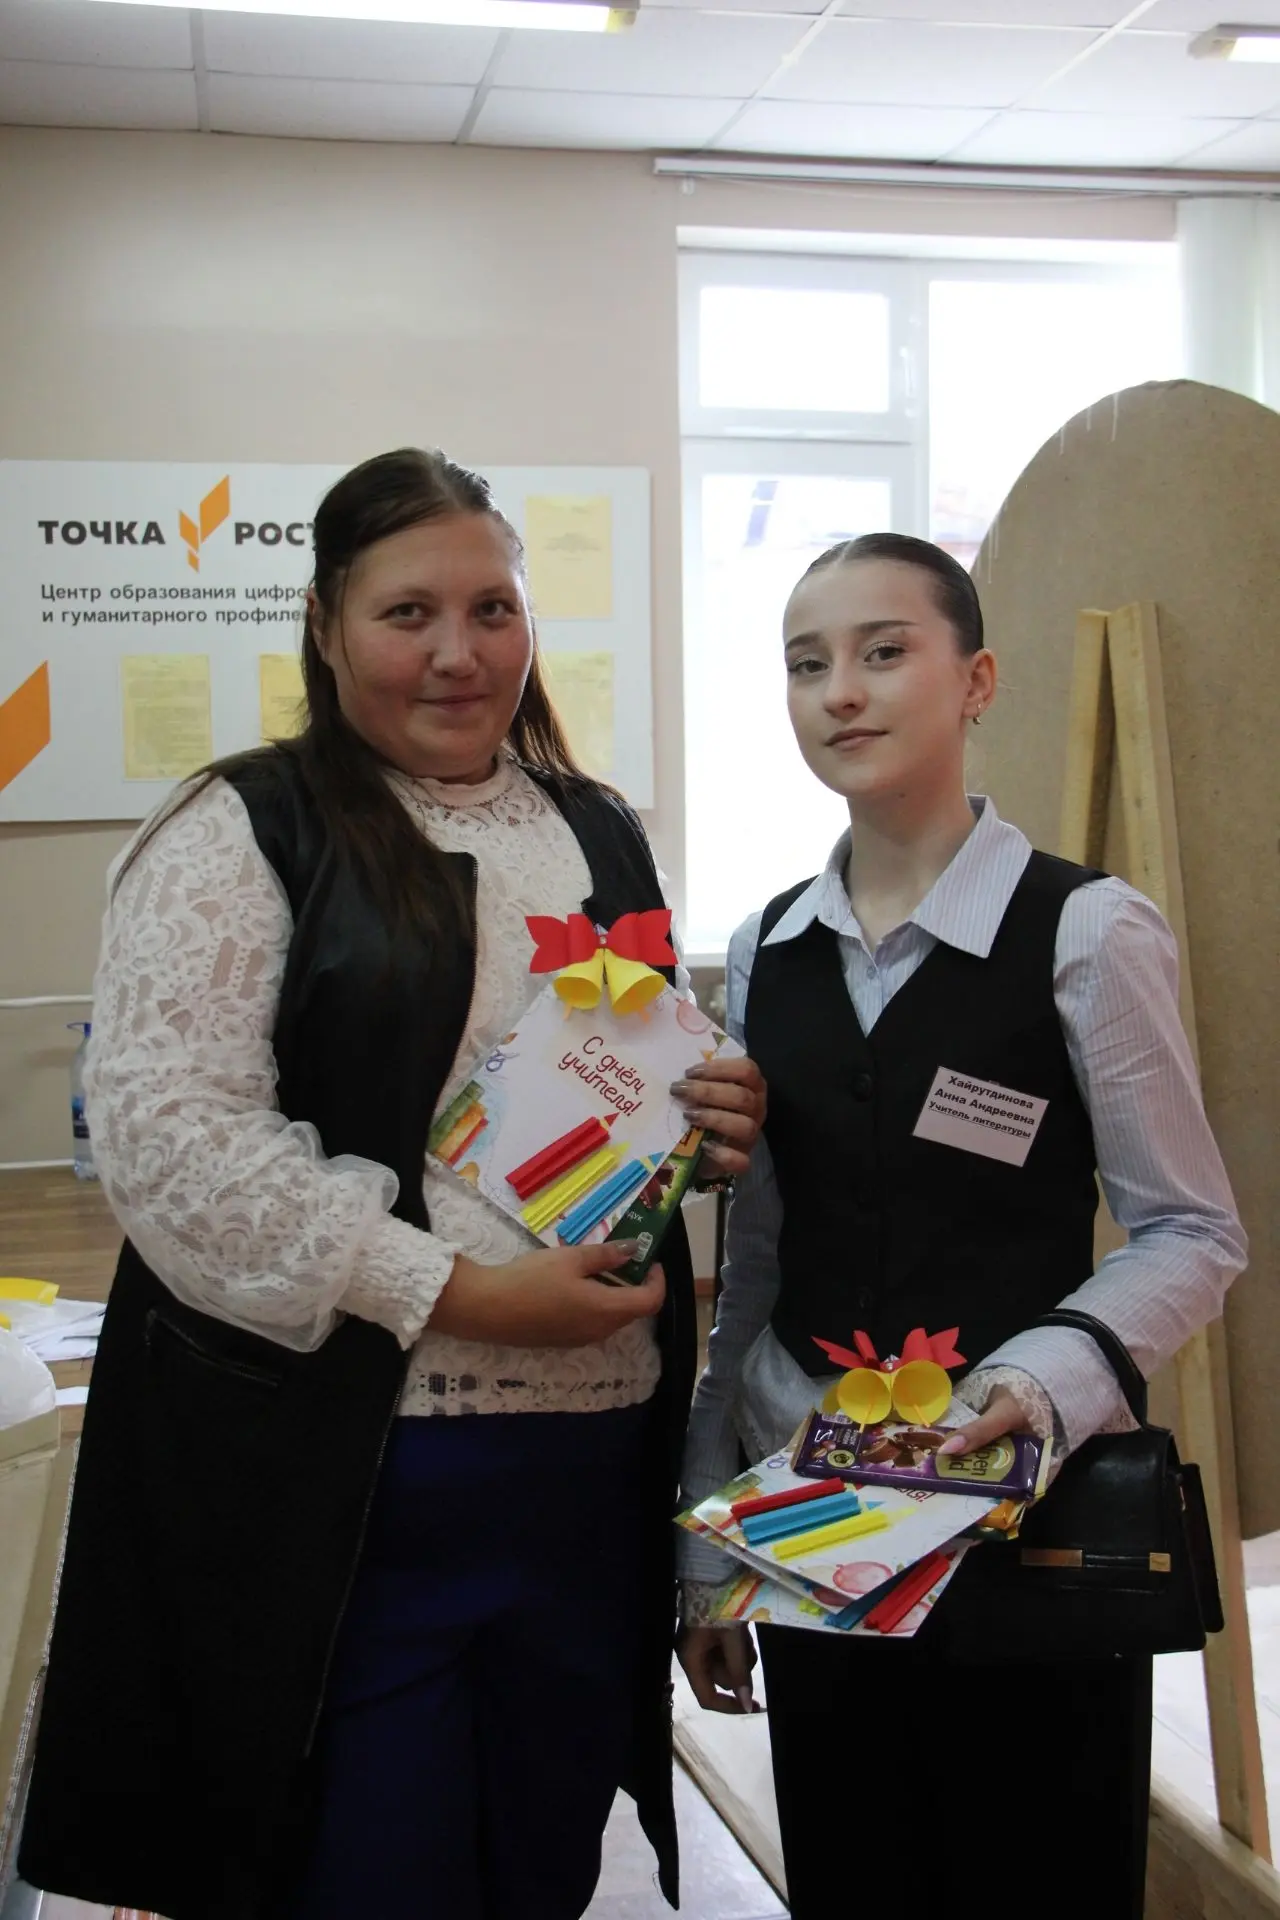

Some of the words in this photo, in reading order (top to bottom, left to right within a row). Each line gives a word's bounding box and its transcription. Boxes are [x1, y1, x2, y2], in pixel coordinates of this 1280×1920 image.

[38, 521, 166, 545] ТОЧКА
[41, 584, 101, 601] Центр
[110, 584, 236, 601] образования
[42, 610, 53, 622] и
[62, 610, 207, 626] гуманитарного
[583, 1036, 604, 1055] С
[595, 1055, 646, 1095] днём
[558, 1051, 643, 1117] учителя!
[948, 1075, 1034, 1109] Хайрутдинова
[929, 1101, 970, 1120] Учитель
[972, 1115, 1031, 1138] литературы
[935, 1088, 967, 1104] Анна
[969, 1099, 1035, 1125] Андреевна
[971, 1446, 999, 1476] lpen
